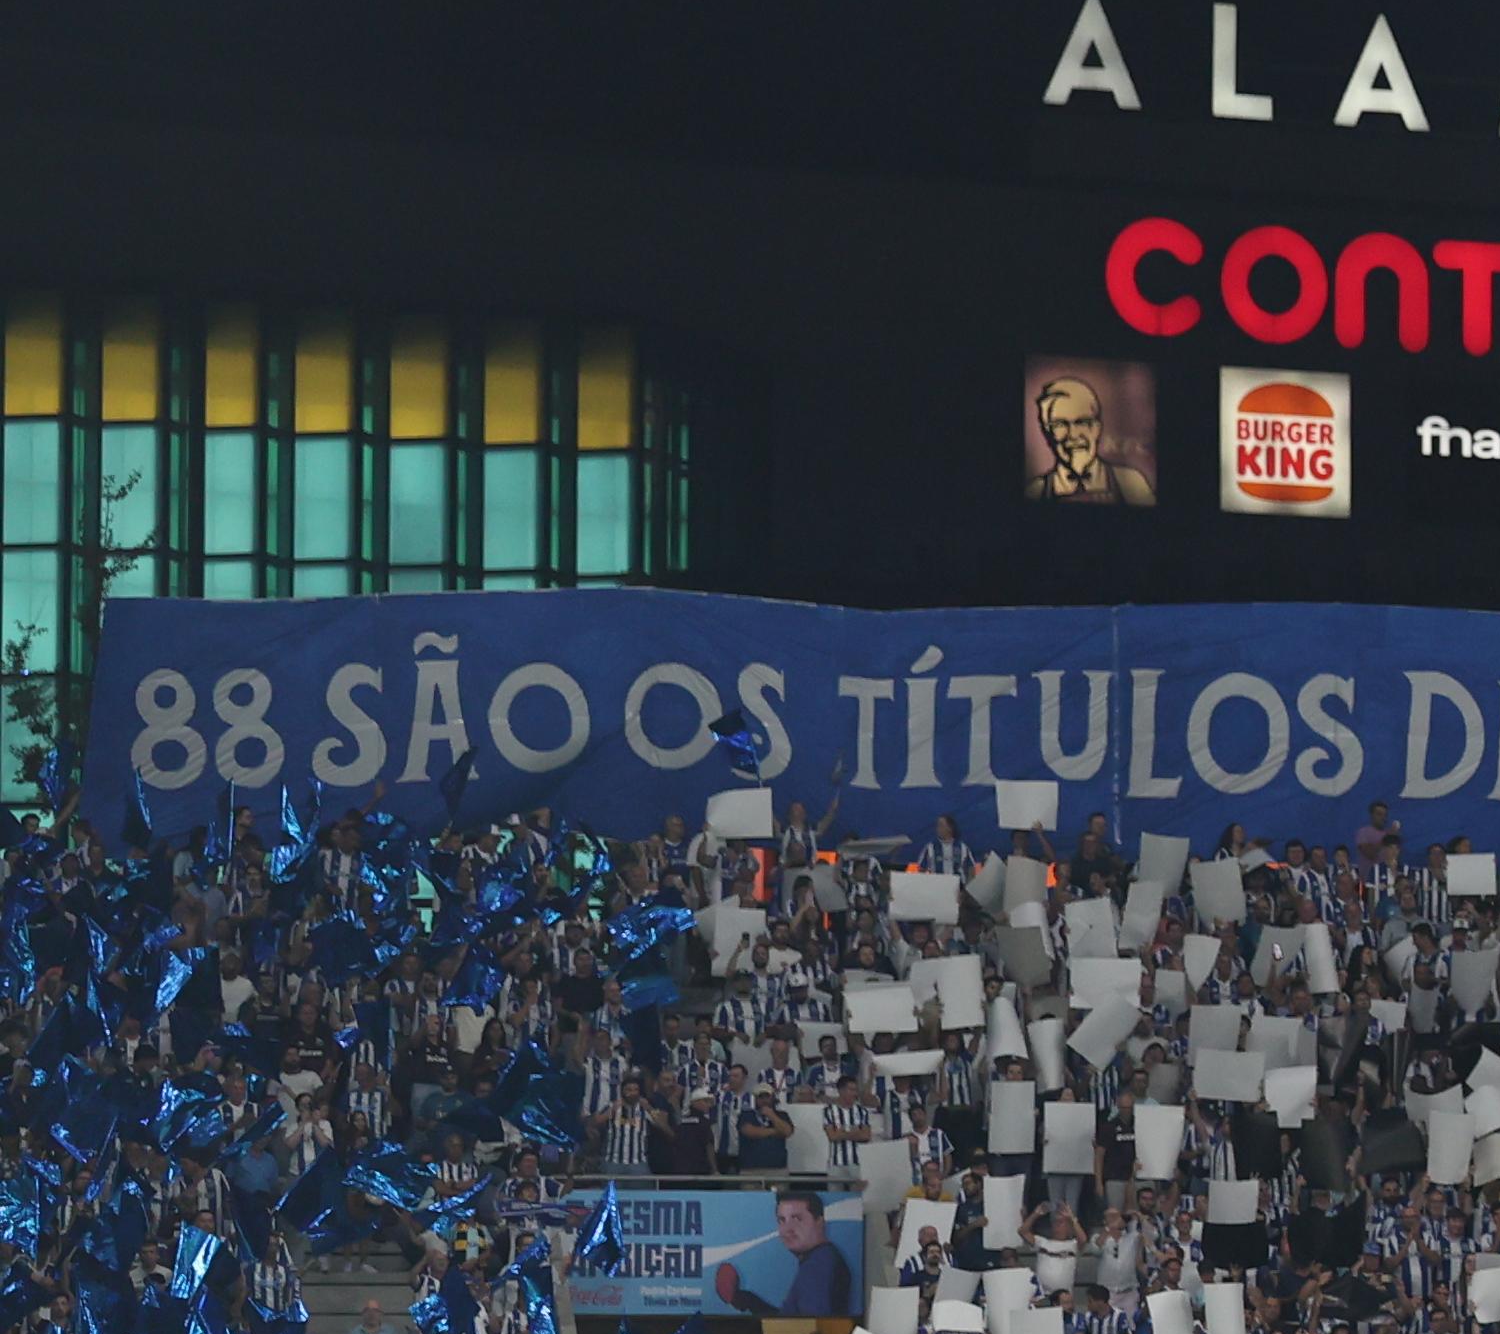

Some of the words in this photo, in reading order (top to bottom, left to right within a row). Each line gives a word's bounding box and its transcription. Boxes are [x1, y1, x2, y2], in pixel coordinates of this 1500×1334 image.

[1236, 418, 1335, 446] BURGER
[1236, 443, 1334, 480] KING
[129, 667, 287, 791] 88
[311, 630, 591, 790] SÃO
[622, 662, 792, 780] OS
[838, 645, 1364, 801] TÍTULOS
